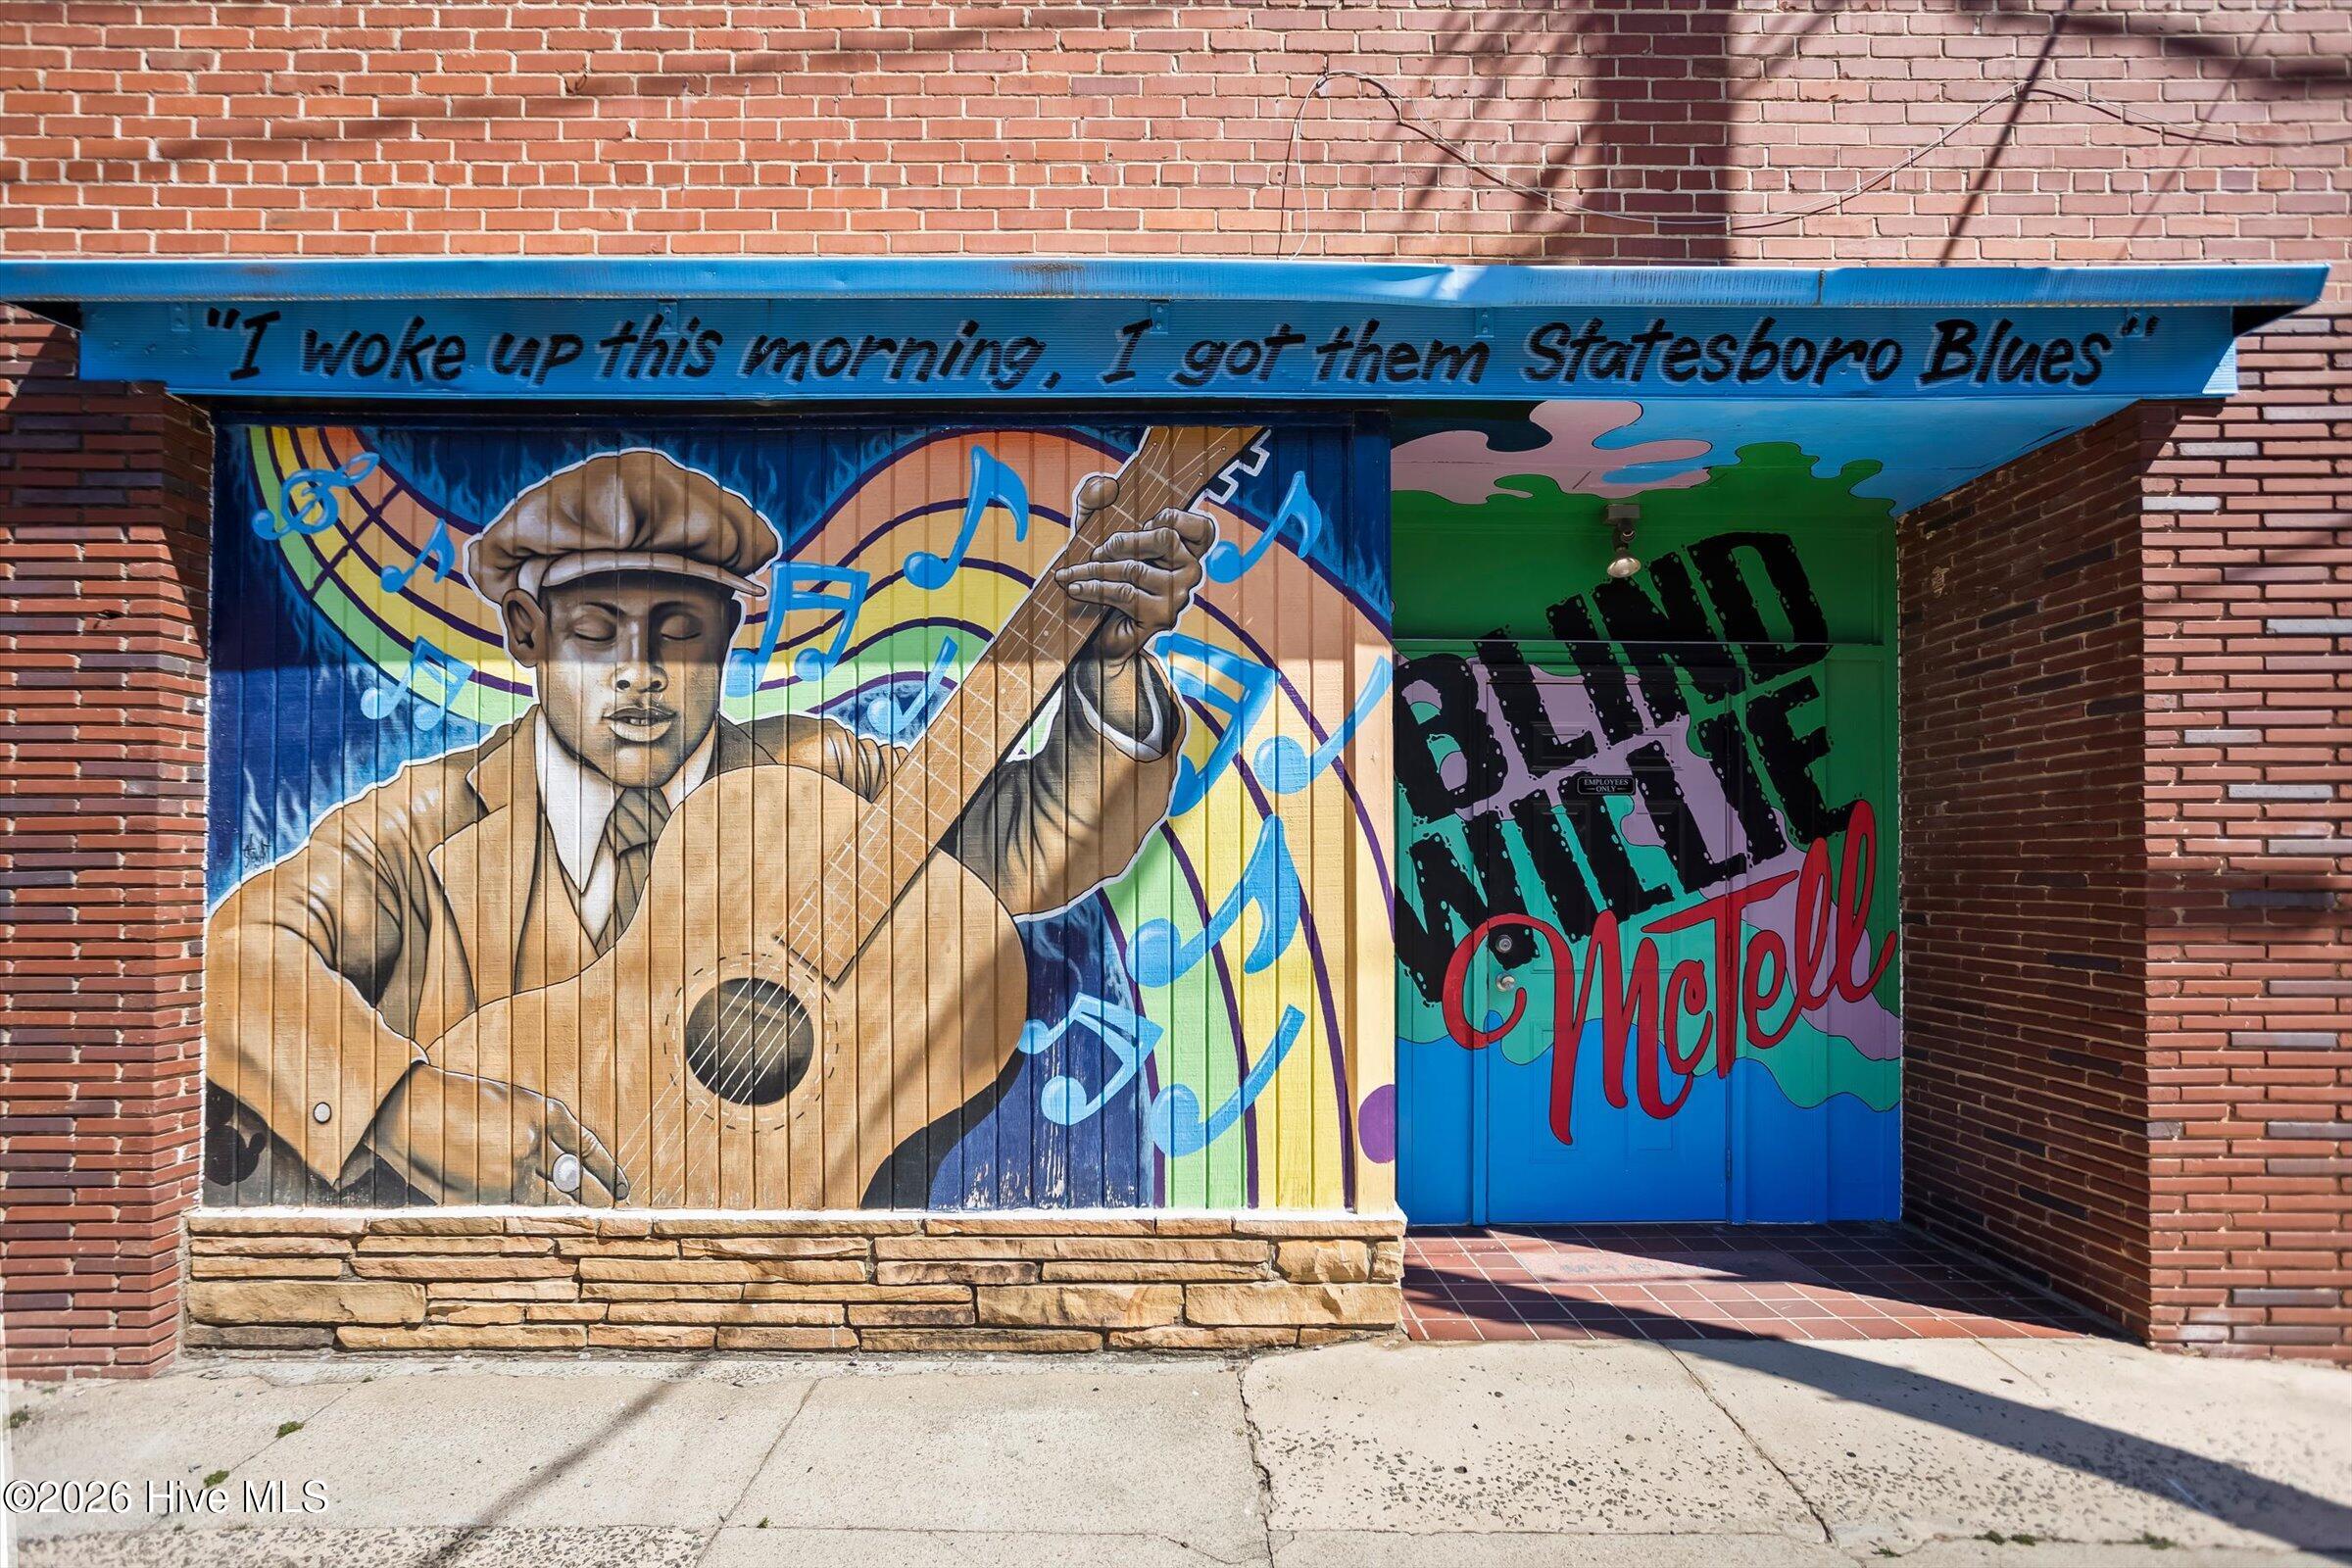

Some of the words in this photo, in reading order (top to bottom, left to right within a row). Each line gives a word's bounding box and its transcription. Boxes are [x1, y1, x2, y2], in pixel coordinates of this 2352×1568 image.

[297, 316, 467, 383] woke
[490, 330, 585, 386] up
[598, 316, 725, 380] this
[738, 319, 1062, 390] morning,
[1102, 317, 1155, 385] I
[1173, 322, 1306, 386] got
[1313, 319, 1490, 384] them
[1520, 316, 1904, 386] Statesboro
[1394, 531, 1833, 823] BLIND
[1394, 674, 1862, 1007] WILLIE
[1442, 799, 1897, 1145] McTell
